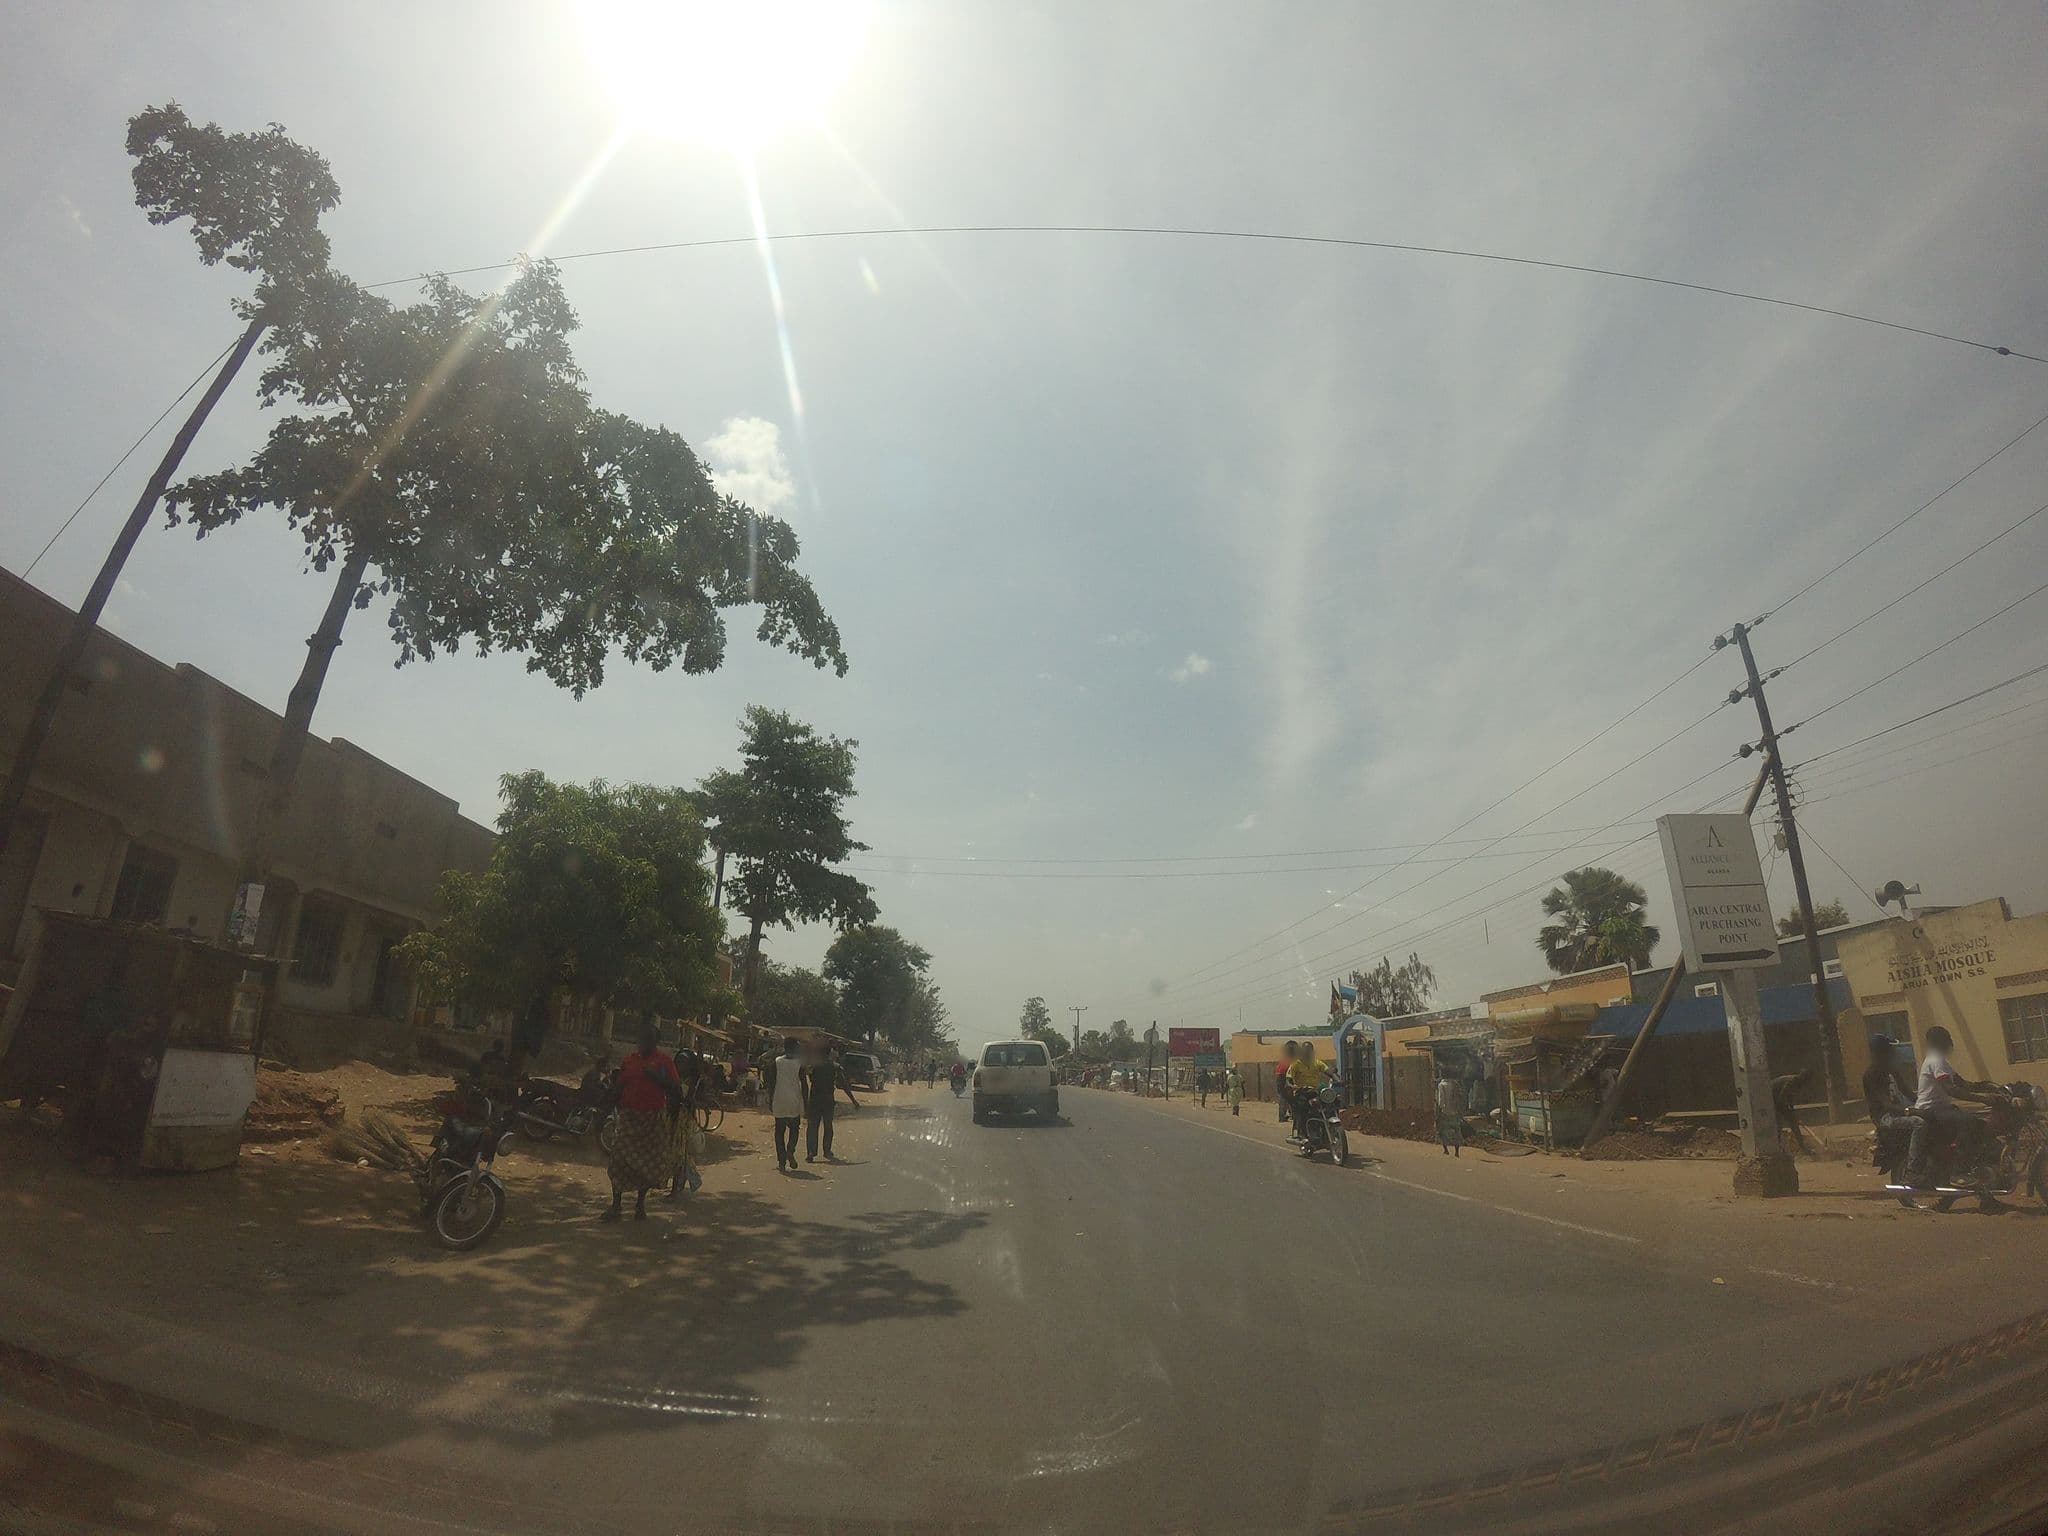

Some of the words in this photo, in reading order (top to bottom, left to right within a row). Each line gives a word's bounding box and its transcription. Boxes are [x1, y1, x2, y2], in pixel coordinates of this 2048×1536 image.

[1692, 905, 1718, 916] ARUA
[1719, 903, 1764, 915] CENTRAL
[1700, 917, 1762, 930] PURCHASING
[1719, 933, 1749, 945] POINT
[1888, 964, 1932, 983] AISHA
[1936, 949, 1996, 973] MOSQUE
[1902, 979, 1929, 991] ARUA
[1933, 971, 1962, 984] TOWN
